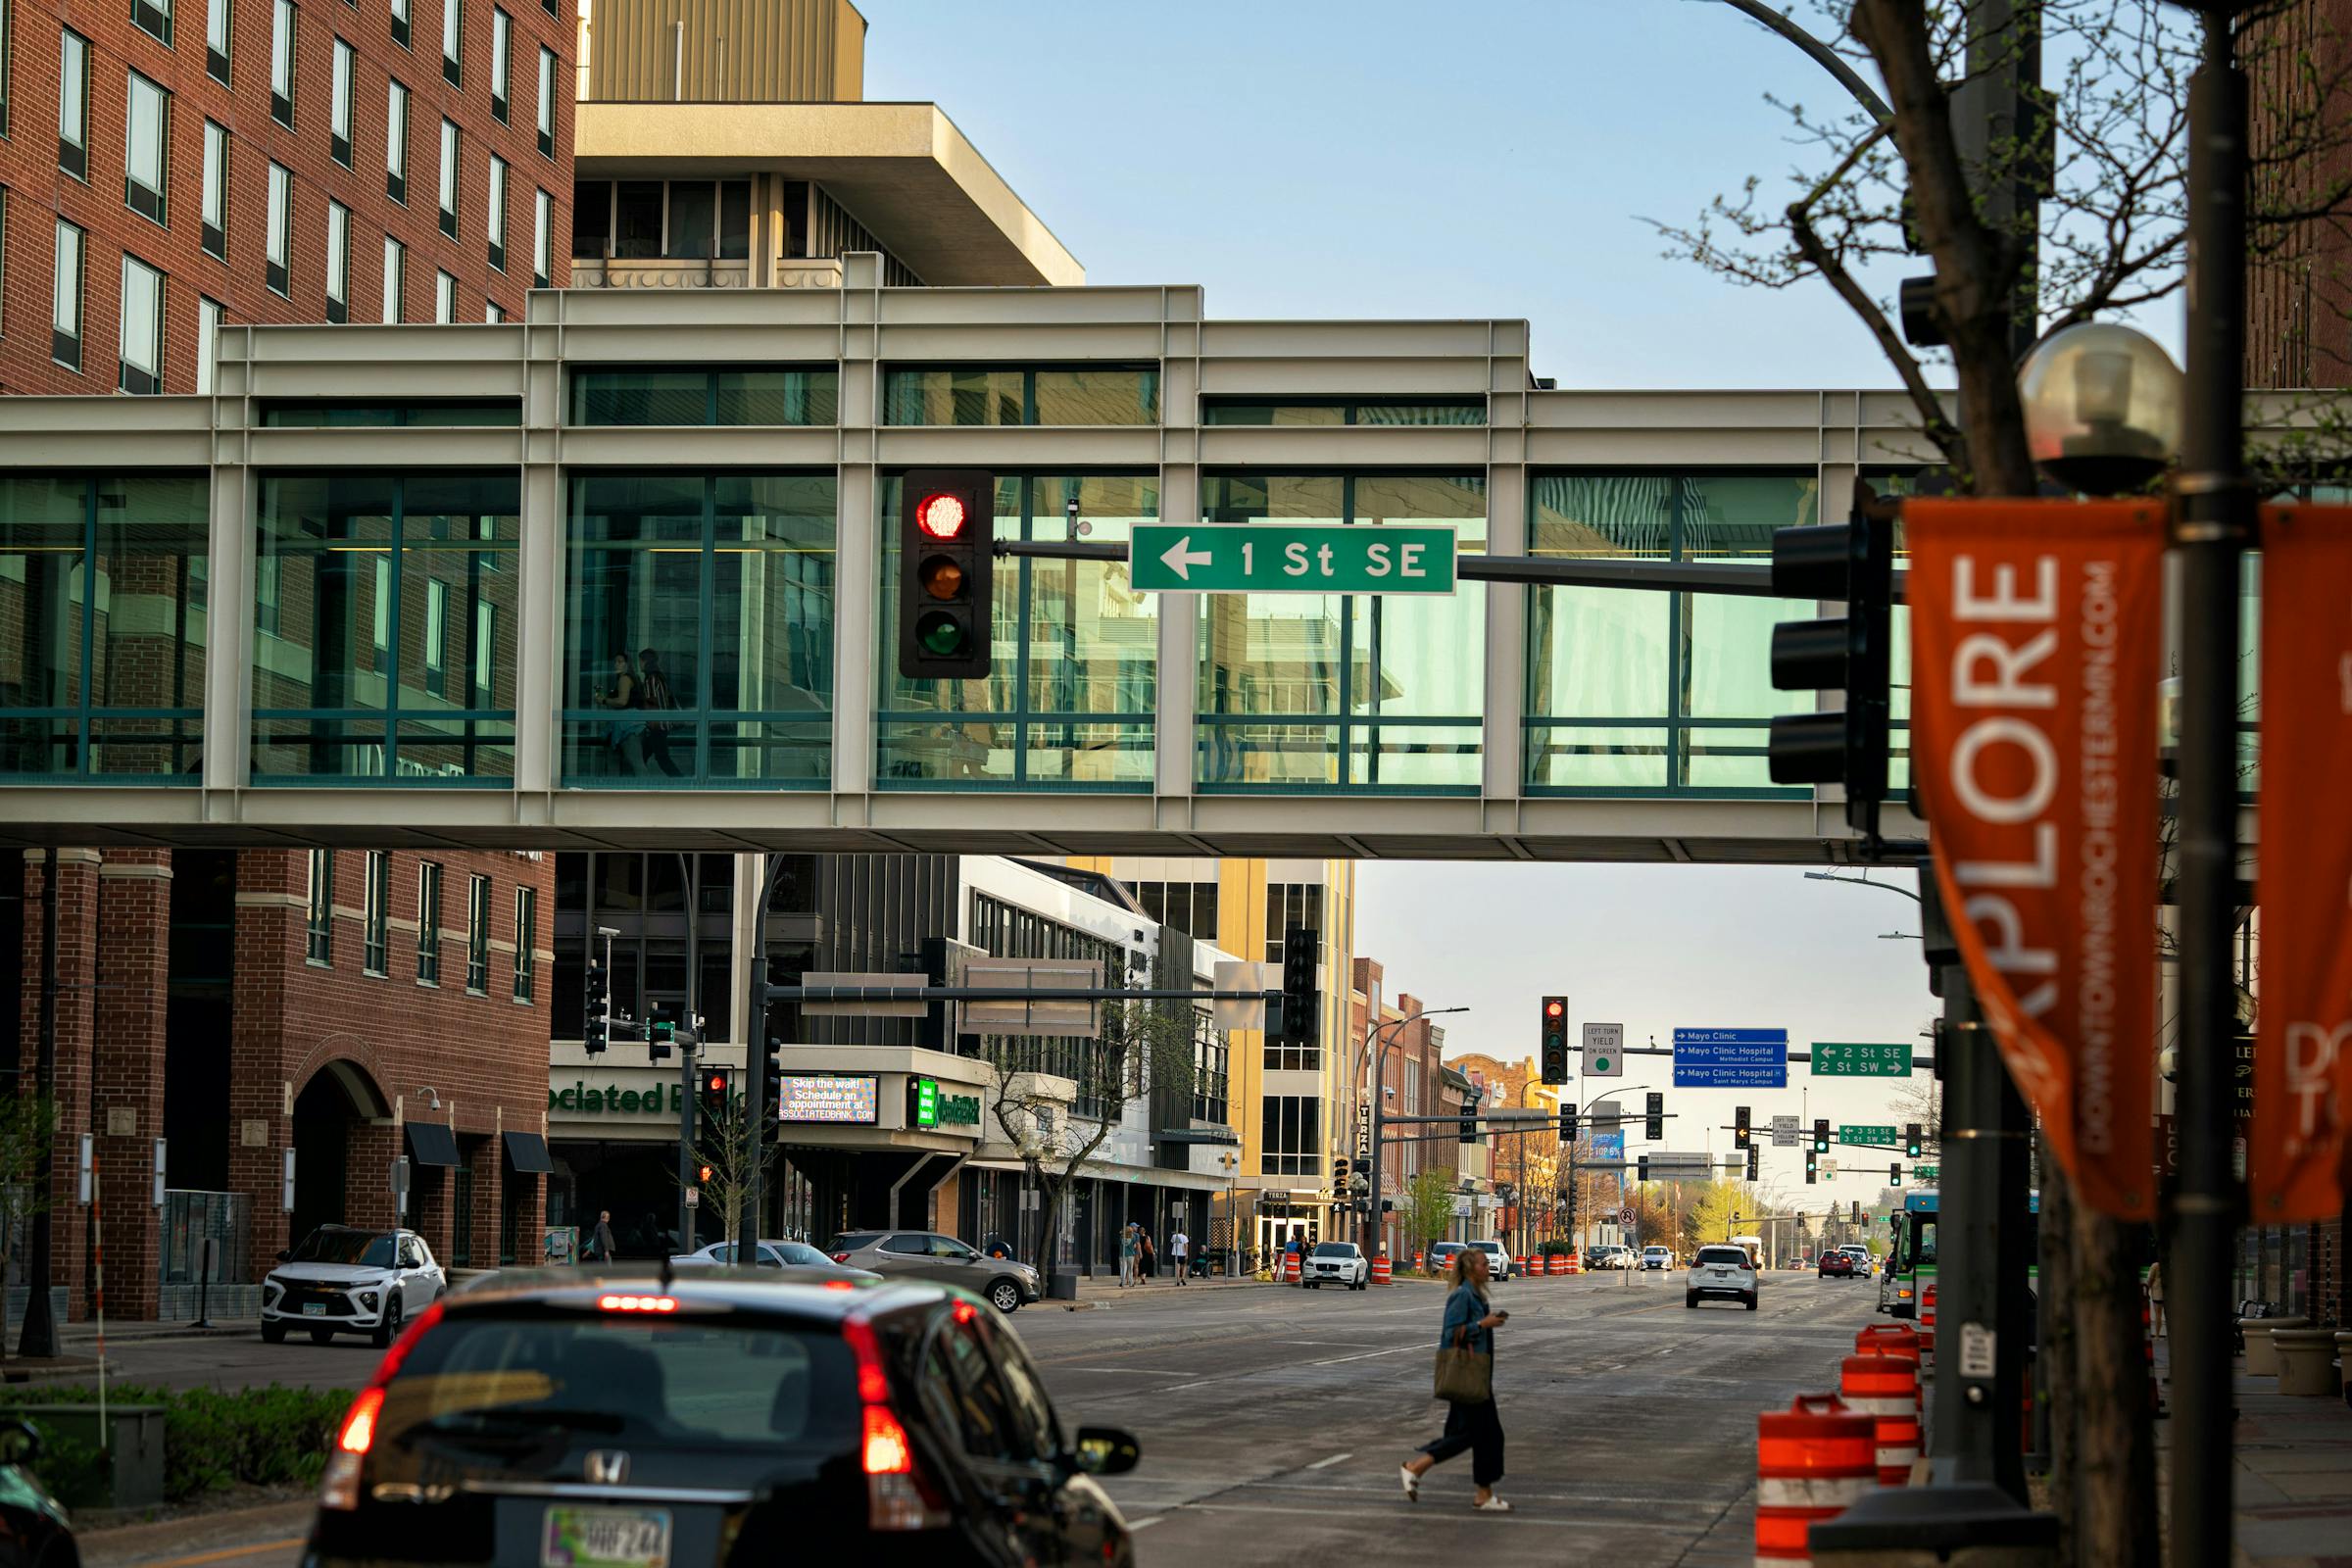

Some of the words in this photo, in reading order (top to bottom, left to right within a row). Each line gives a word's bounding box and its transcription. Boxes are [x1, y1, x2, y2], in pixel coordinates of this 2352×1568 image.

[1242, 542, 1253, 576] 1
[1283, 542, 1335, 576] St
[1364, 543, 1427, 578] SE
[1592, 1037, 1614, 1046] YIELD
[1688, 1032, 1710, 1042] Mayo
[1688, 1047, 1710, 1056] Mayo
[1739, 1047, 1774, 1055] Hospital
[1843, 1048, 1852, 1057] 2
[1860, 1048, 1876, 1058] St
[1884, 1048, 1901, 1058] SE
[1820, 1061, 1829, 1072] 2
[1837, 1061, 1851, 1072] St
[1859, 1062, 1880, 1073] SW
[1688, 1069, 1710, 1078] Mayo
[1712, 1068, 1737, 1077] Clinic
[1739, 1069, 1774, 1078] Hospital
[792, 1078, 814, 1089] Skip
[816, 1079, 834, 1088] the
[836, 1079, 859, 1089] wait!
[795, 1090, 842, 1100] Schedule
[788, 1100, 851, 1109] appointment
[853, 1100, 863, 1109] at
[779, 1109, 873, 1119] ASSOCIATEDBANK.COM
[1360, 1106, 1369, 1152] TERZA
